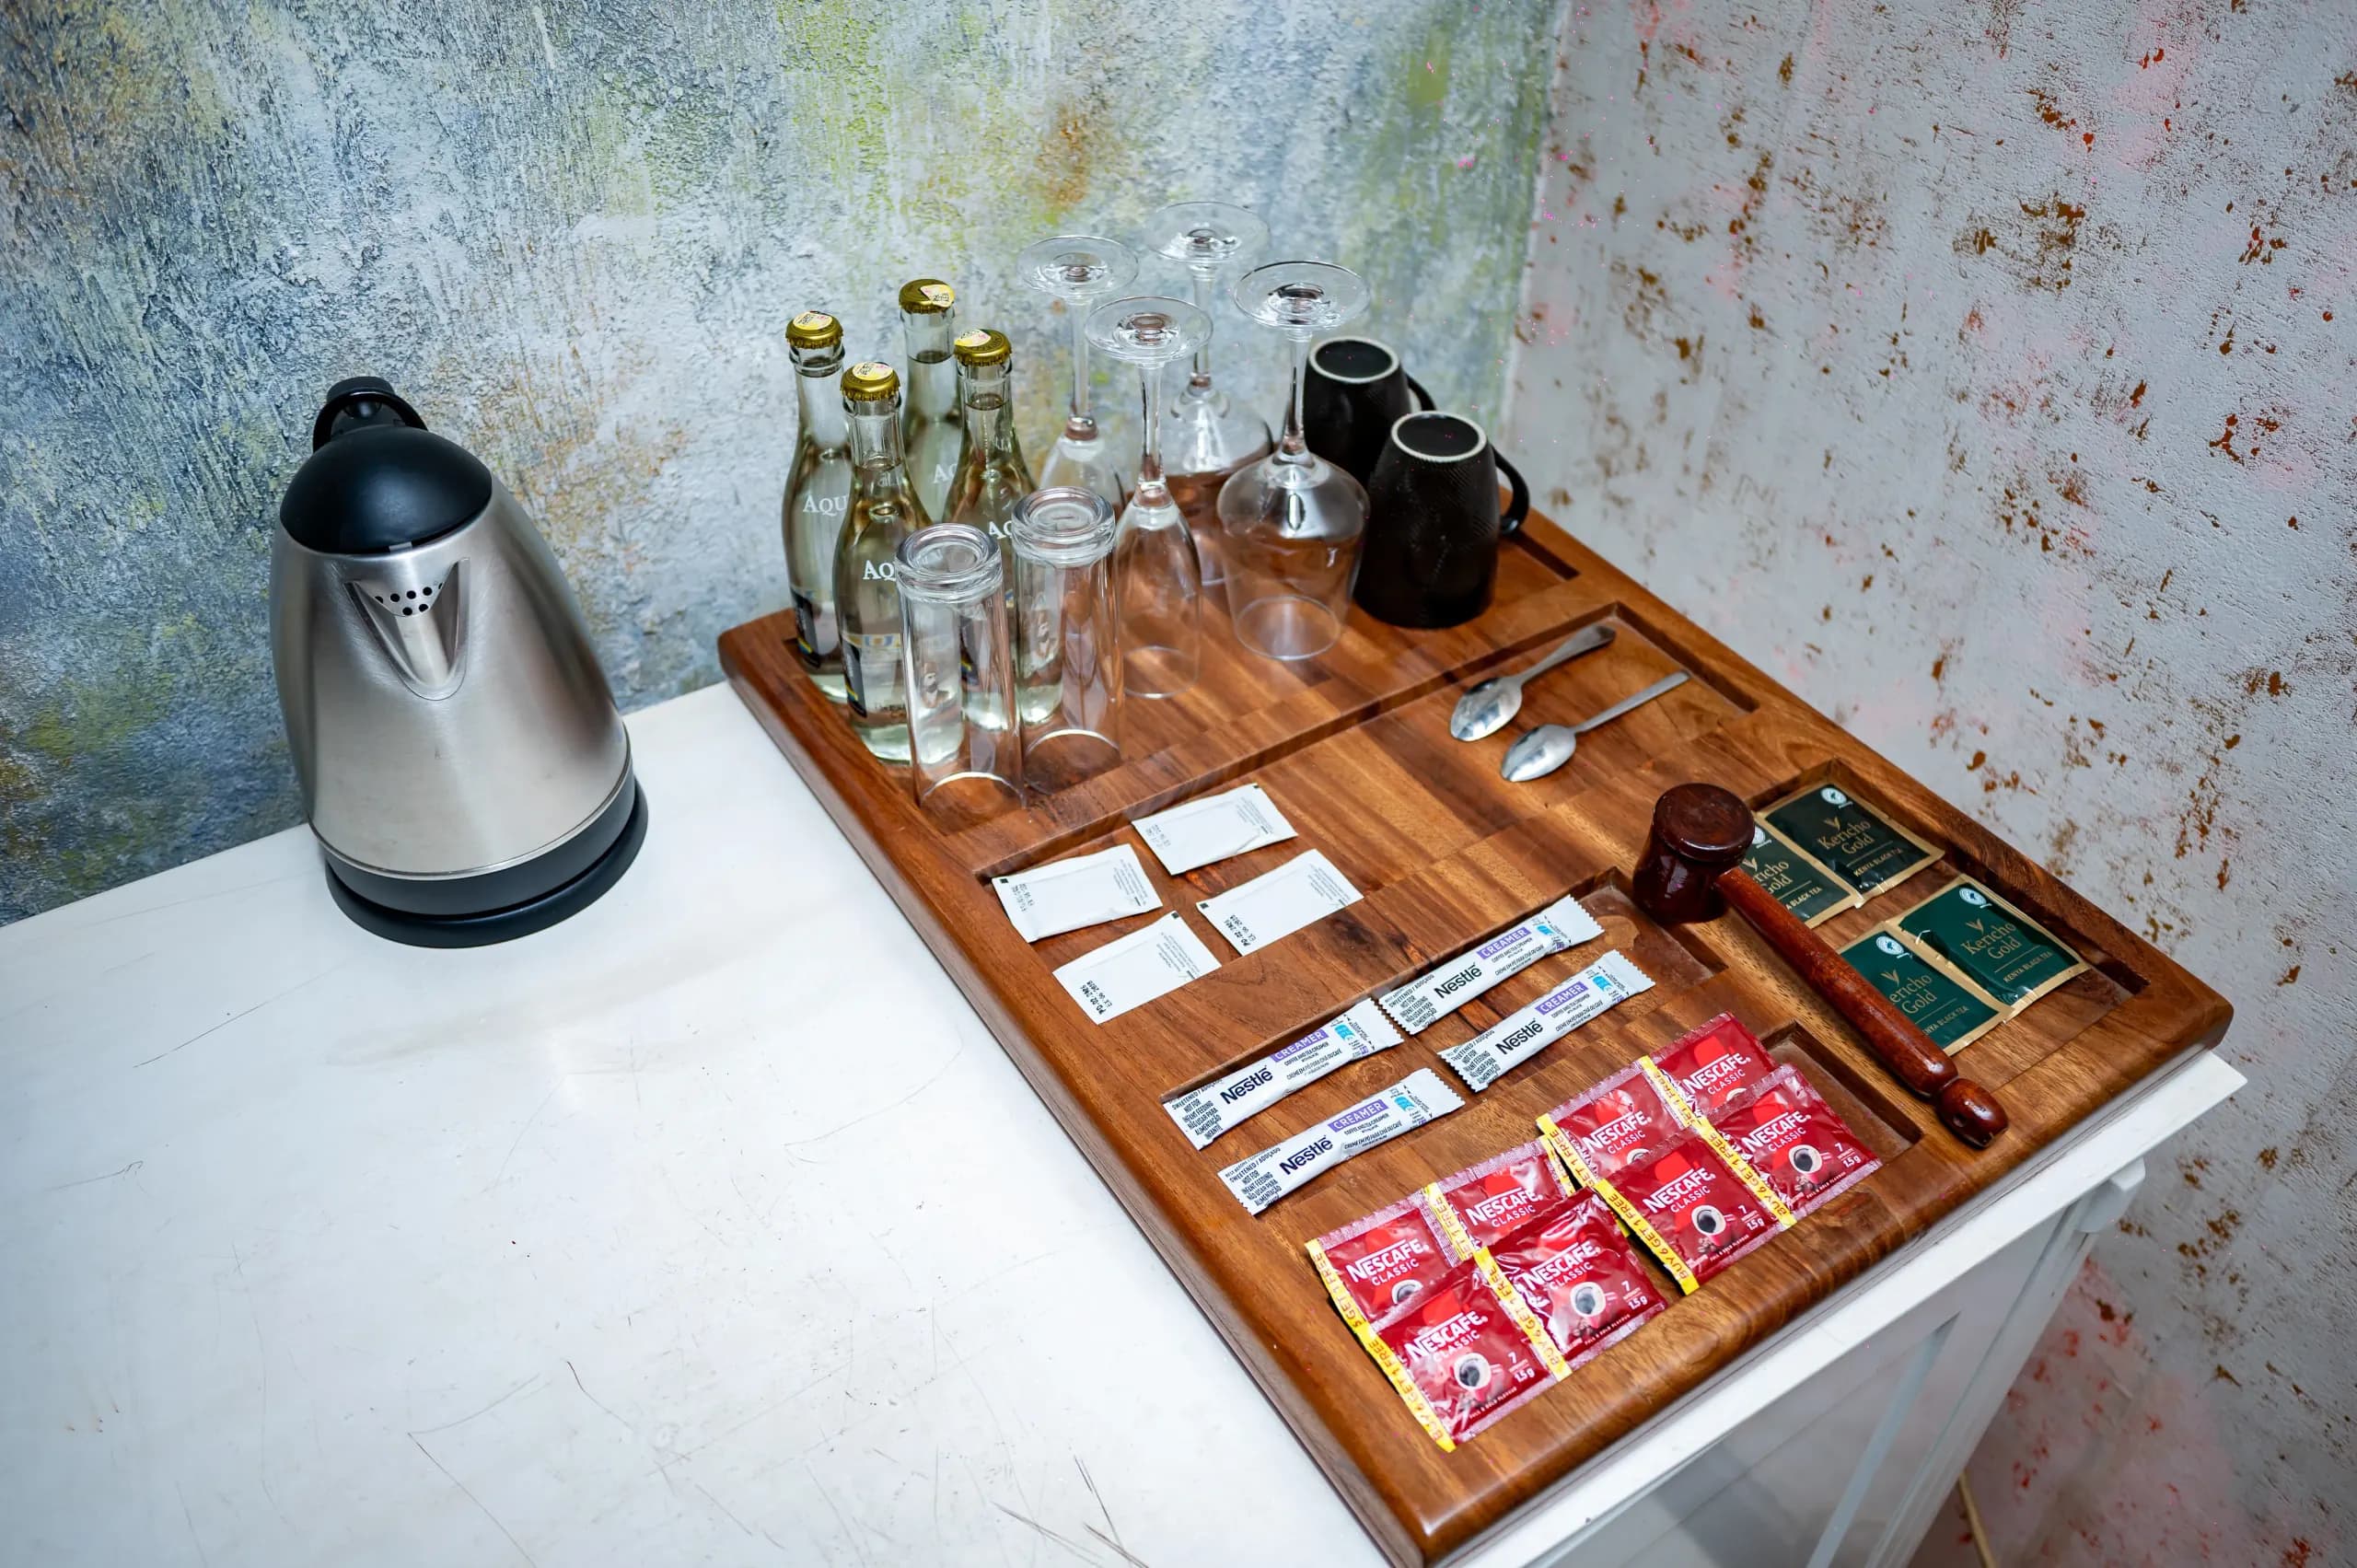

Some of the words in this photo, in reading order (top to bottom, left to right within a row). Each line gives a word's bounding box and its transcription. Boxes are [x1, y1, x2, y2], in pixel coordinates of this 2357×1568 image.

[1817, 819, 1872, 851] Kericho
[1841, 833, 1875, 854] Gold
[1853, 862, 1875, 877] KENYA
[1789, 892, 1811, 907] BLACK
[1808, 886, 1822, 896] TEA
[1481, 929, 1527, 957] CREAMER
[1960, 922, 2016, 955] Kericho
[1988, 937, 2022, 959] Gold
[2003, 968, 2025, 982] KENYA
[2023, 958, 2045, 973] BLACK
[2040, 950, 2053, 962] TEA
[1434, 964, 1482, 999] Nestlé
[1889, 974, 1933, 1005] ericho
[1388, 990, 1413, 1008] SWEETENED
[1540, 983, 1585, 1011] CREAMER
[1901, 989, 1937, 1013] Gold
[1937, 1012, 1958, 1026] BLACK
[1955, 1005, 1969, 1016] TEA
[1274, 1031, 1324, 1060] CREAMER
[1495, 1019, 1543, 1055] Nestlé
[1468, 1049, 1479, 1058] FOR
[1220, 1067, 1273, 1104] Nestlé
[1708, 1069, 1747, 1095] CLASSIC
[1170, 1091, 1200, 1109] SWEETENED
[1190, 1098, 1202, 1107] FOR
[1204, 1107, 1218, 1117] PARA
[1333, 1102, 1384, 1129] CREAMER
[1550, 1129, 1573, 1157] FREE
[1607, 1130, 1646, 1154] CLASSIC
[1708, 1132, 1734, 1158] FREE
[1768, 1127, 1806, 1152] CLASSIC
[1280, 1136, 1333, 1175] Nestlé
[1228, 1162, 1258, 1182] SWEETENED
[1248, 1169, 1260, 1179] FOR
[1264, 1179, 1278, 1188] PARA
[1738, 1167, 1759, 1186] GET
[1608, 1193, 1635, 1219] FREE
[1670, 1185, 1711, 1213] CLASSIC
[1764, 1195, 1787, 1215] BUY
[1436, 1197, 1455, 1228] FREE
[1491, 1204, 1537, 1228] CLASSIC
[1639, 1227, 1661, 1248] GET
[1312, 1252, 1336, 1284] FREE
[1371, 1259, 1420, 1286] CLASSIC
[1550, 1261, 1594, 1291] CLASSIC
[1666, 1256, 1689, 1279] BUY
[1490, 1266, 1512, 1296] FREE
[1337, 1295, 1356, 1319] GET
[1368, 1340, 1392, 1368] FREE
[1433, 1330, 1481, 1363] CLASSIC
